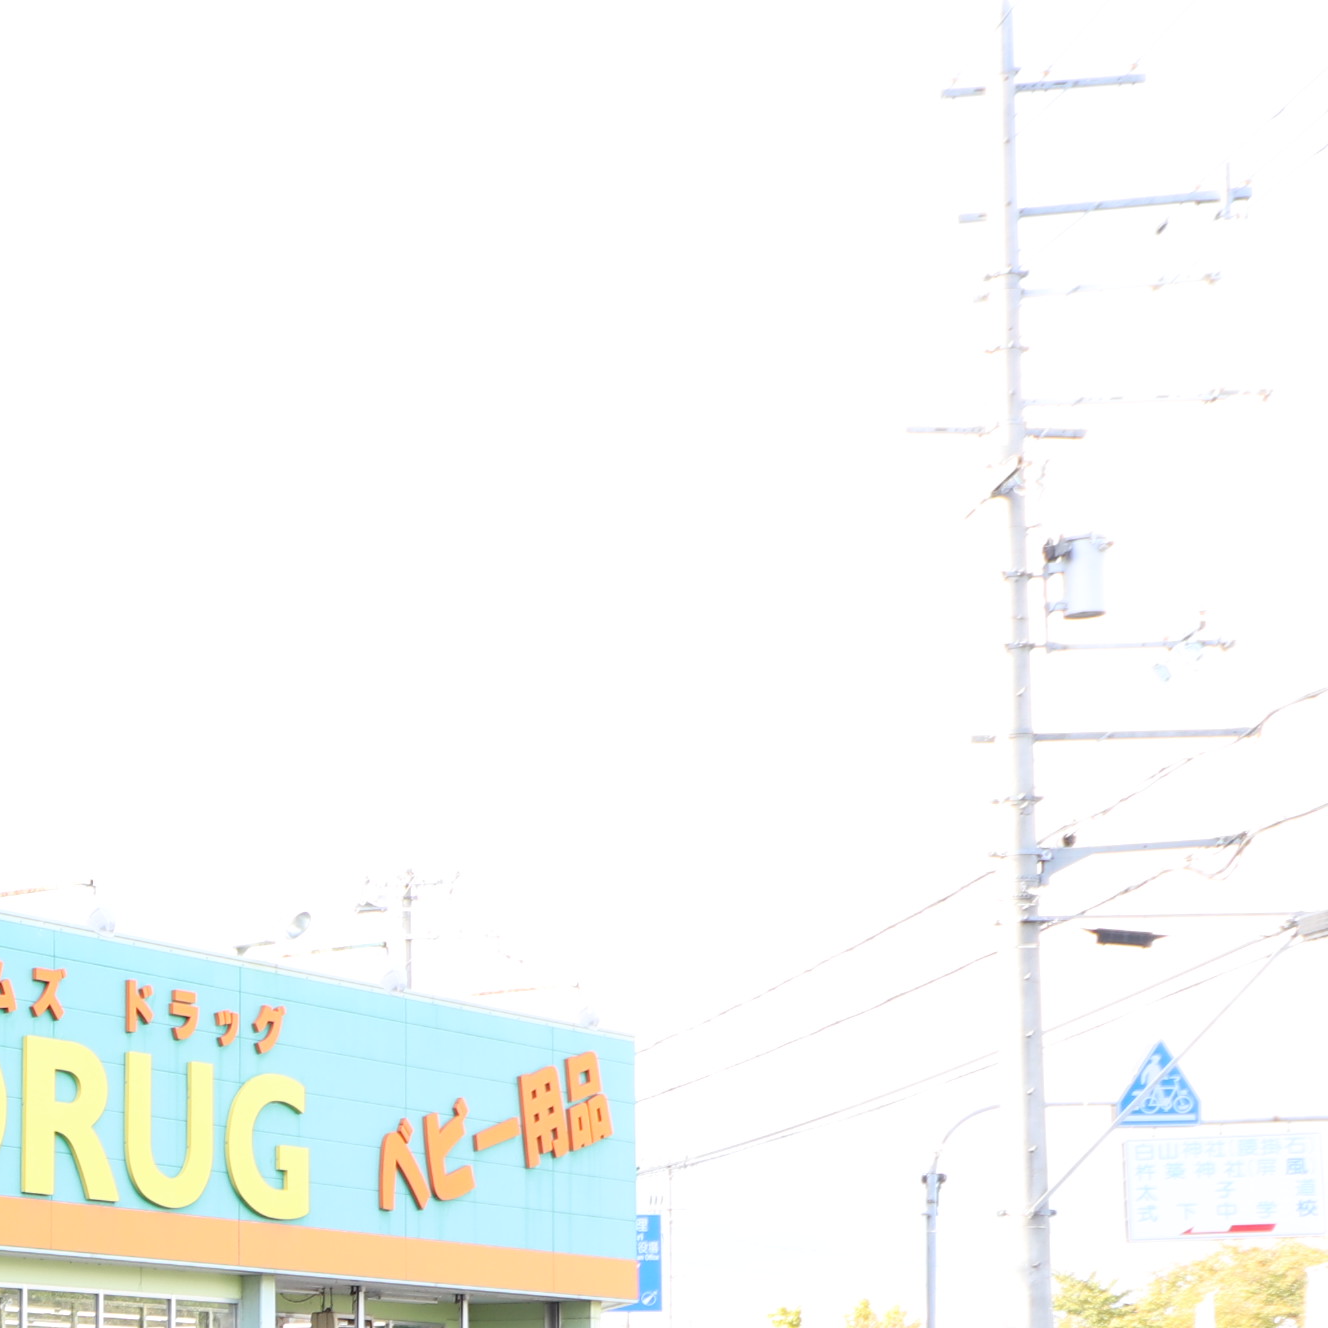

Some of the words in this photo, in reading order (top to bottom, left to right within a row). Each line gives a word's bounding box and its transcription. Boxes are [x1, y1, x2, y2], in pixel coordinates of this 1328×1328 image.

[125, 979, 287, 1055] ドラッグ
[378, 1050, 615, 1212] ベビー用品
